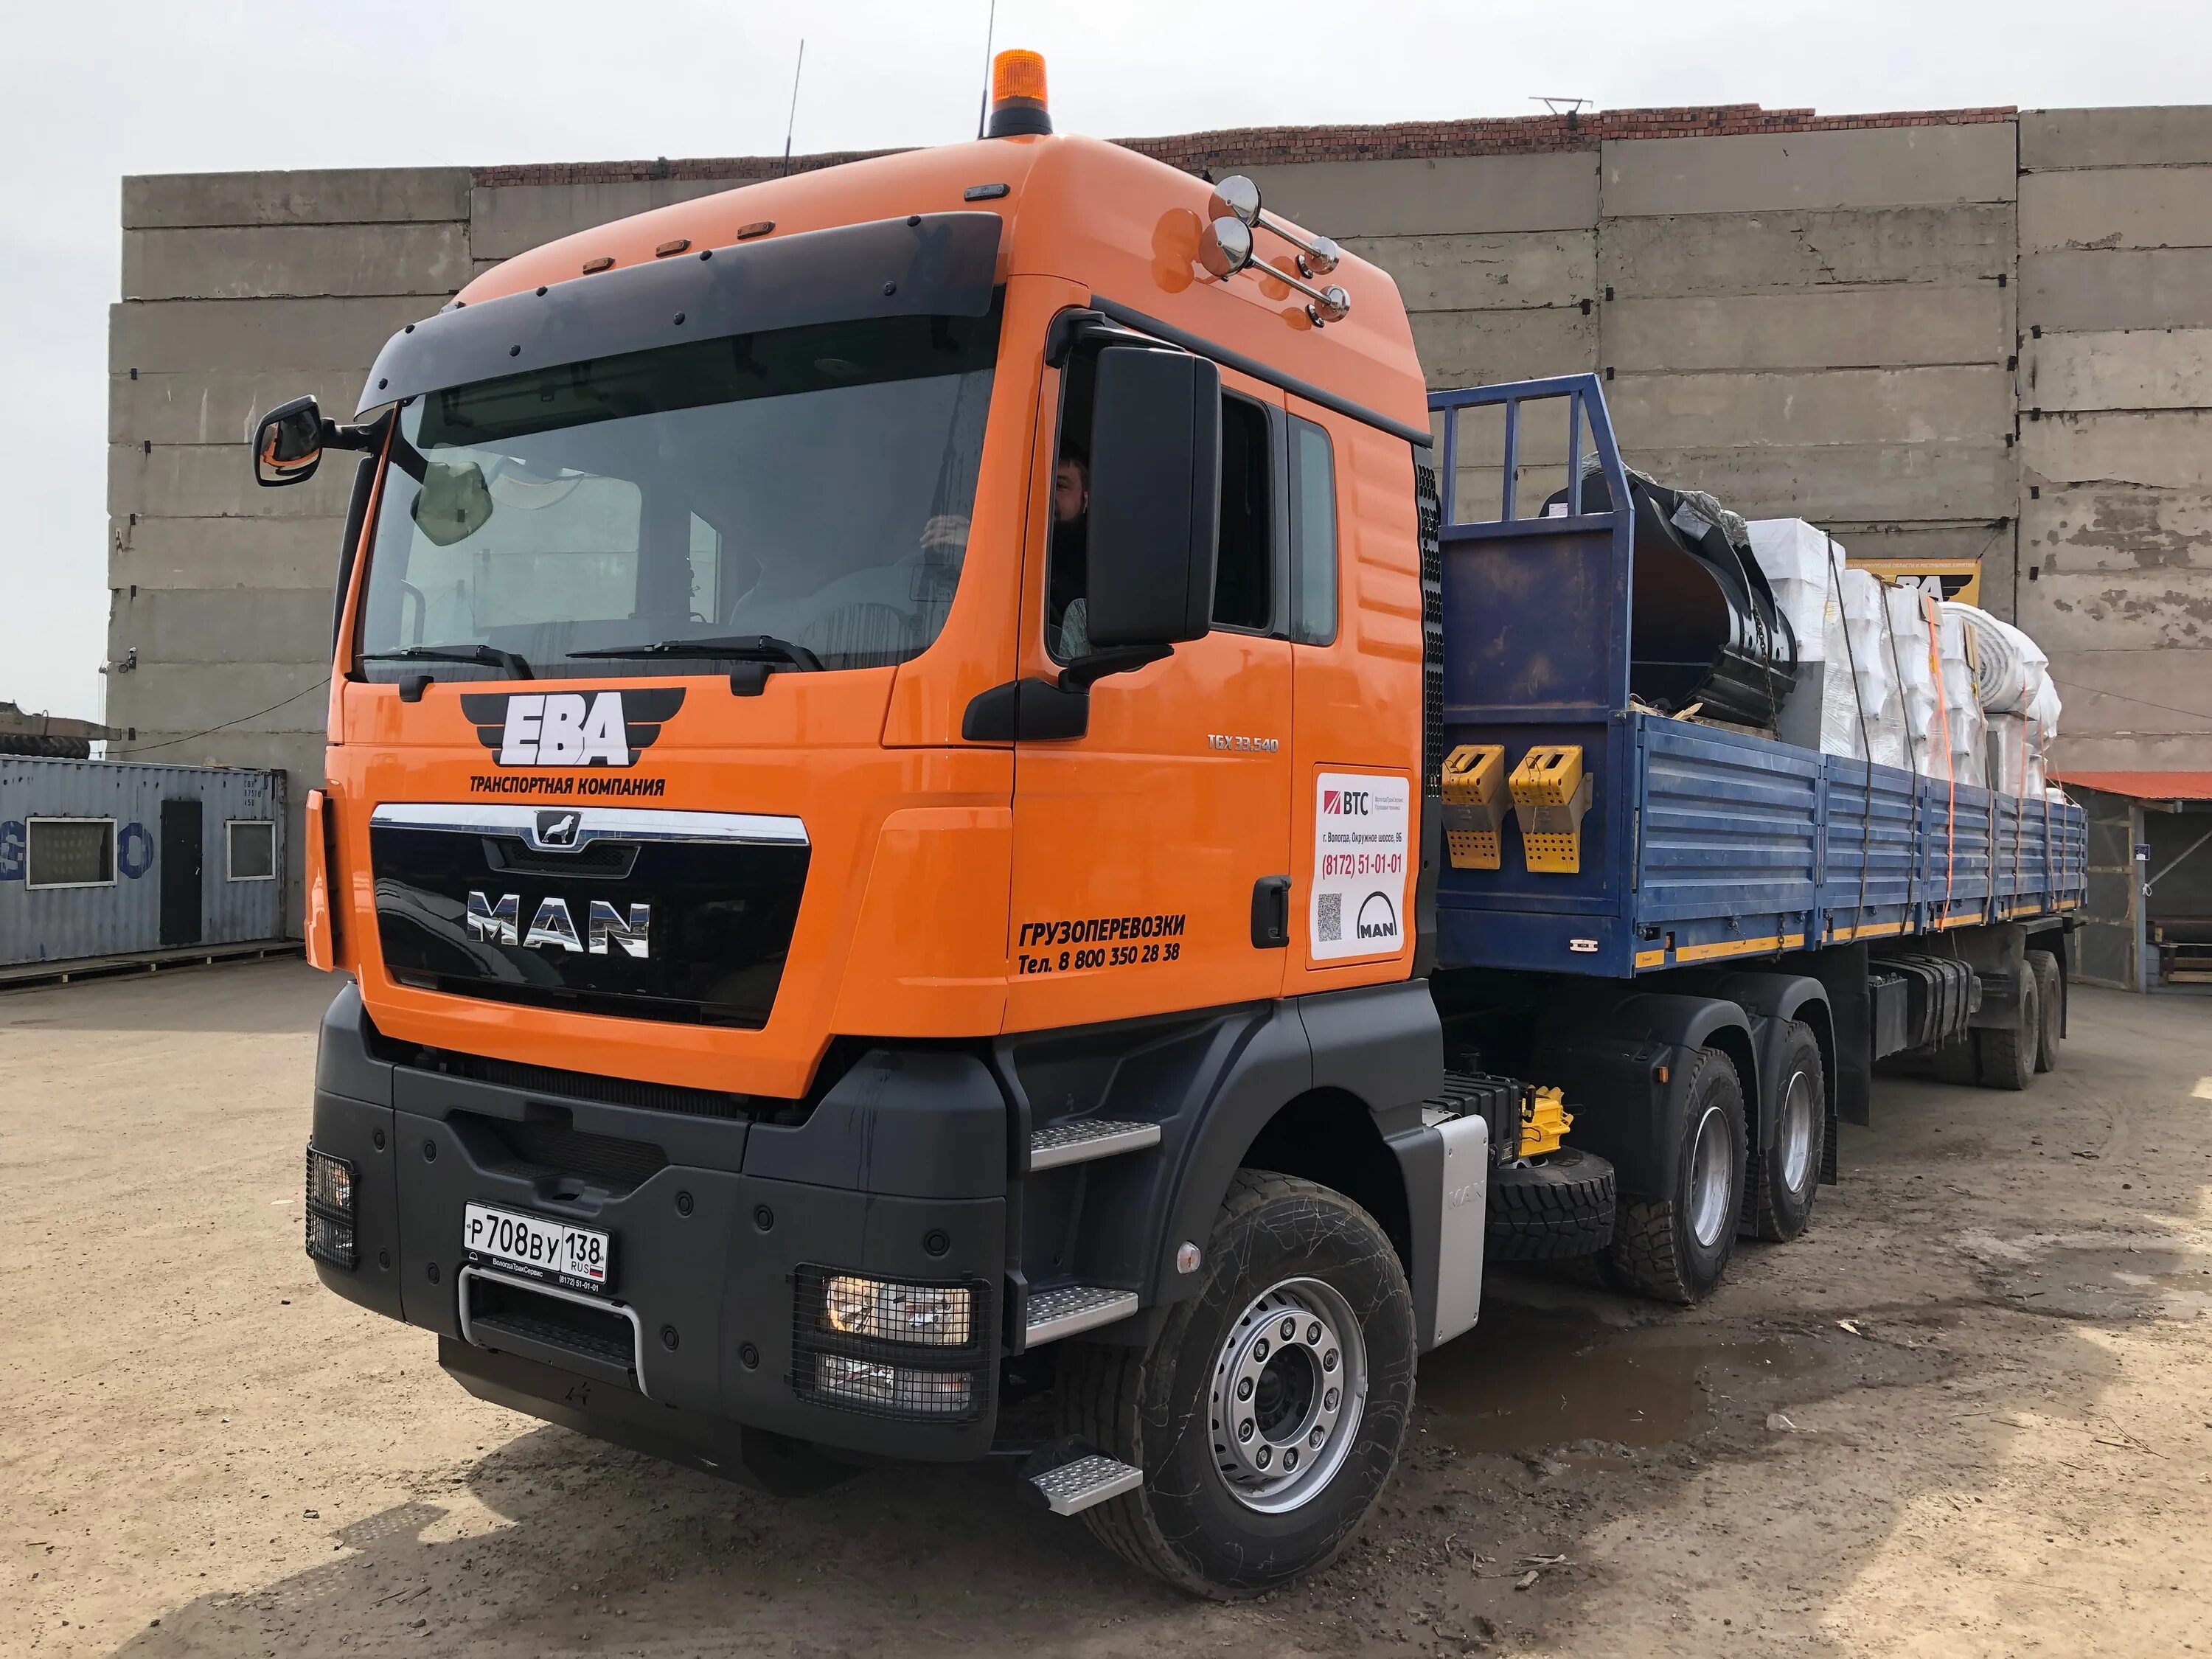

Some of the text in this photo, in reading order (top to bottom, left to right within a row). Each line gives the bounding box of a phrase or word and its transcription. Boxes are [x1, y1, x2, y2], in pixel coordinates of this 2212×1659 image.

[500, 692, 630, 765] ЕВА
[1207, 734, 1279, 753] TGX 33.540
[470, 776, 665, 796] ТРАНСПОРТНАЯ КОМПАНИЯ
[1328, 832, 1351, 844] Вологда,
[1352, 832, 1377, 844] Окружное
[1378, 834, 1395, 844] шоссе,
[1322, 854, 1402, 880] (8172) 51-01-01
[467, 891, 651, 959] MAN
[1018, 914, 1186, 947] ГРУЗОПЕРЕВОЗКИ
[1360, 922, 1395, 939] MAN
[1018, 942, 1180, 975] Тел. 8 800 350 28 38
[566, 1232, 600, 1264] 138
[493, 1257, 543, 1277] ВологдаТракСервис
[571, 1262, 589, 1273] RUS
[559, 1276, 599, 1292] (8172) 51-01-01
